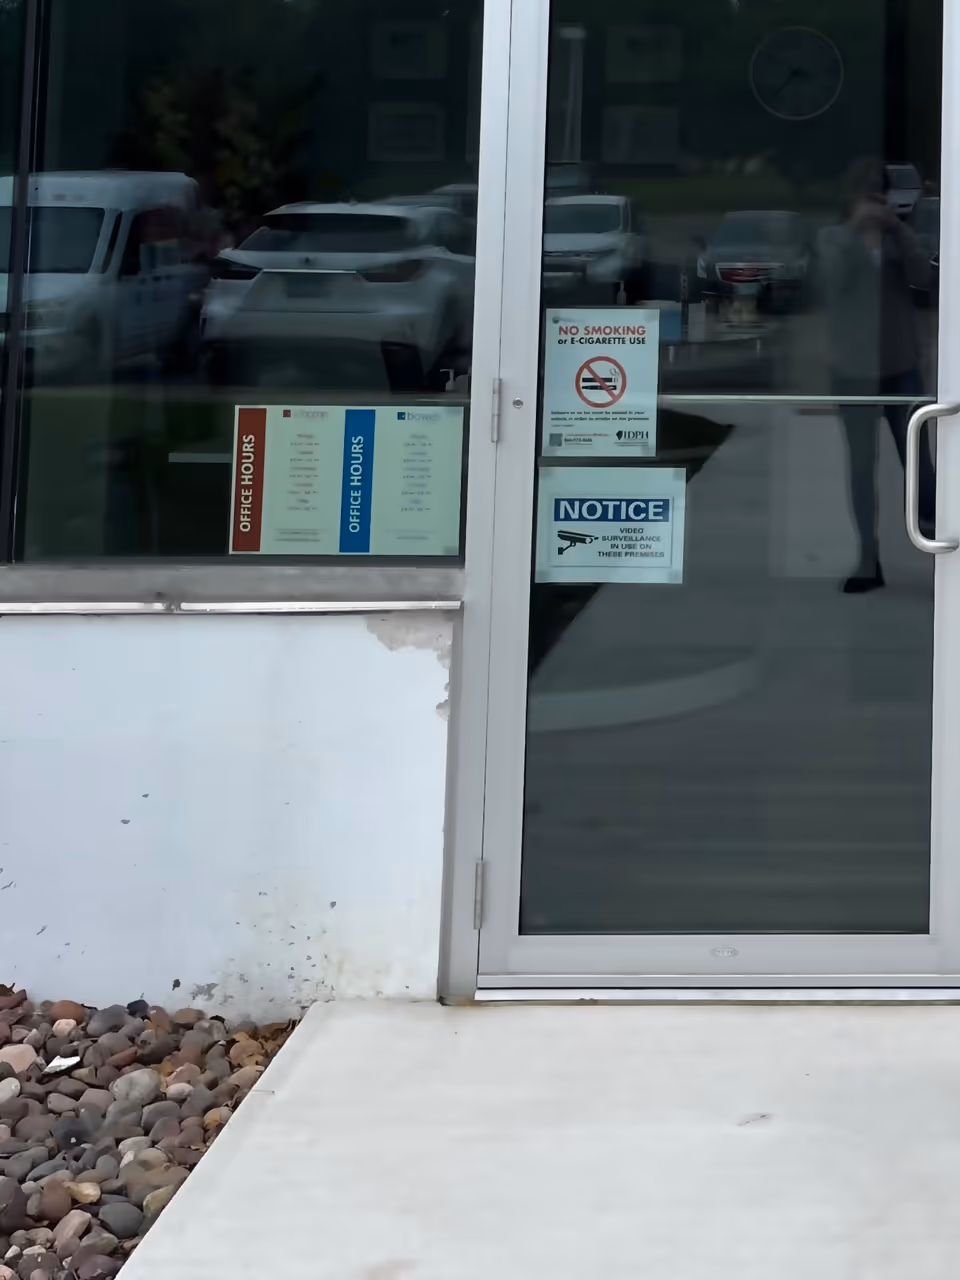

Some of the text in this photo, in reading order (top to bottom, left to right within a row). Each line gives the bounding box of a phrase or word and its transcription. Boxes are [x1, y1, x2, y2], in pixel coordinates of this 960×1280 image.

[557, 336, 646, 345] or E-CIGARETTE USE
[558, 325, 647, 336] NO SMOKING
[239, 434, 255, 532] OFFICE HOURS
[348, 435, 364, 533] OFFICE HOURS
[559, 500, 664, 520] NOTICE
